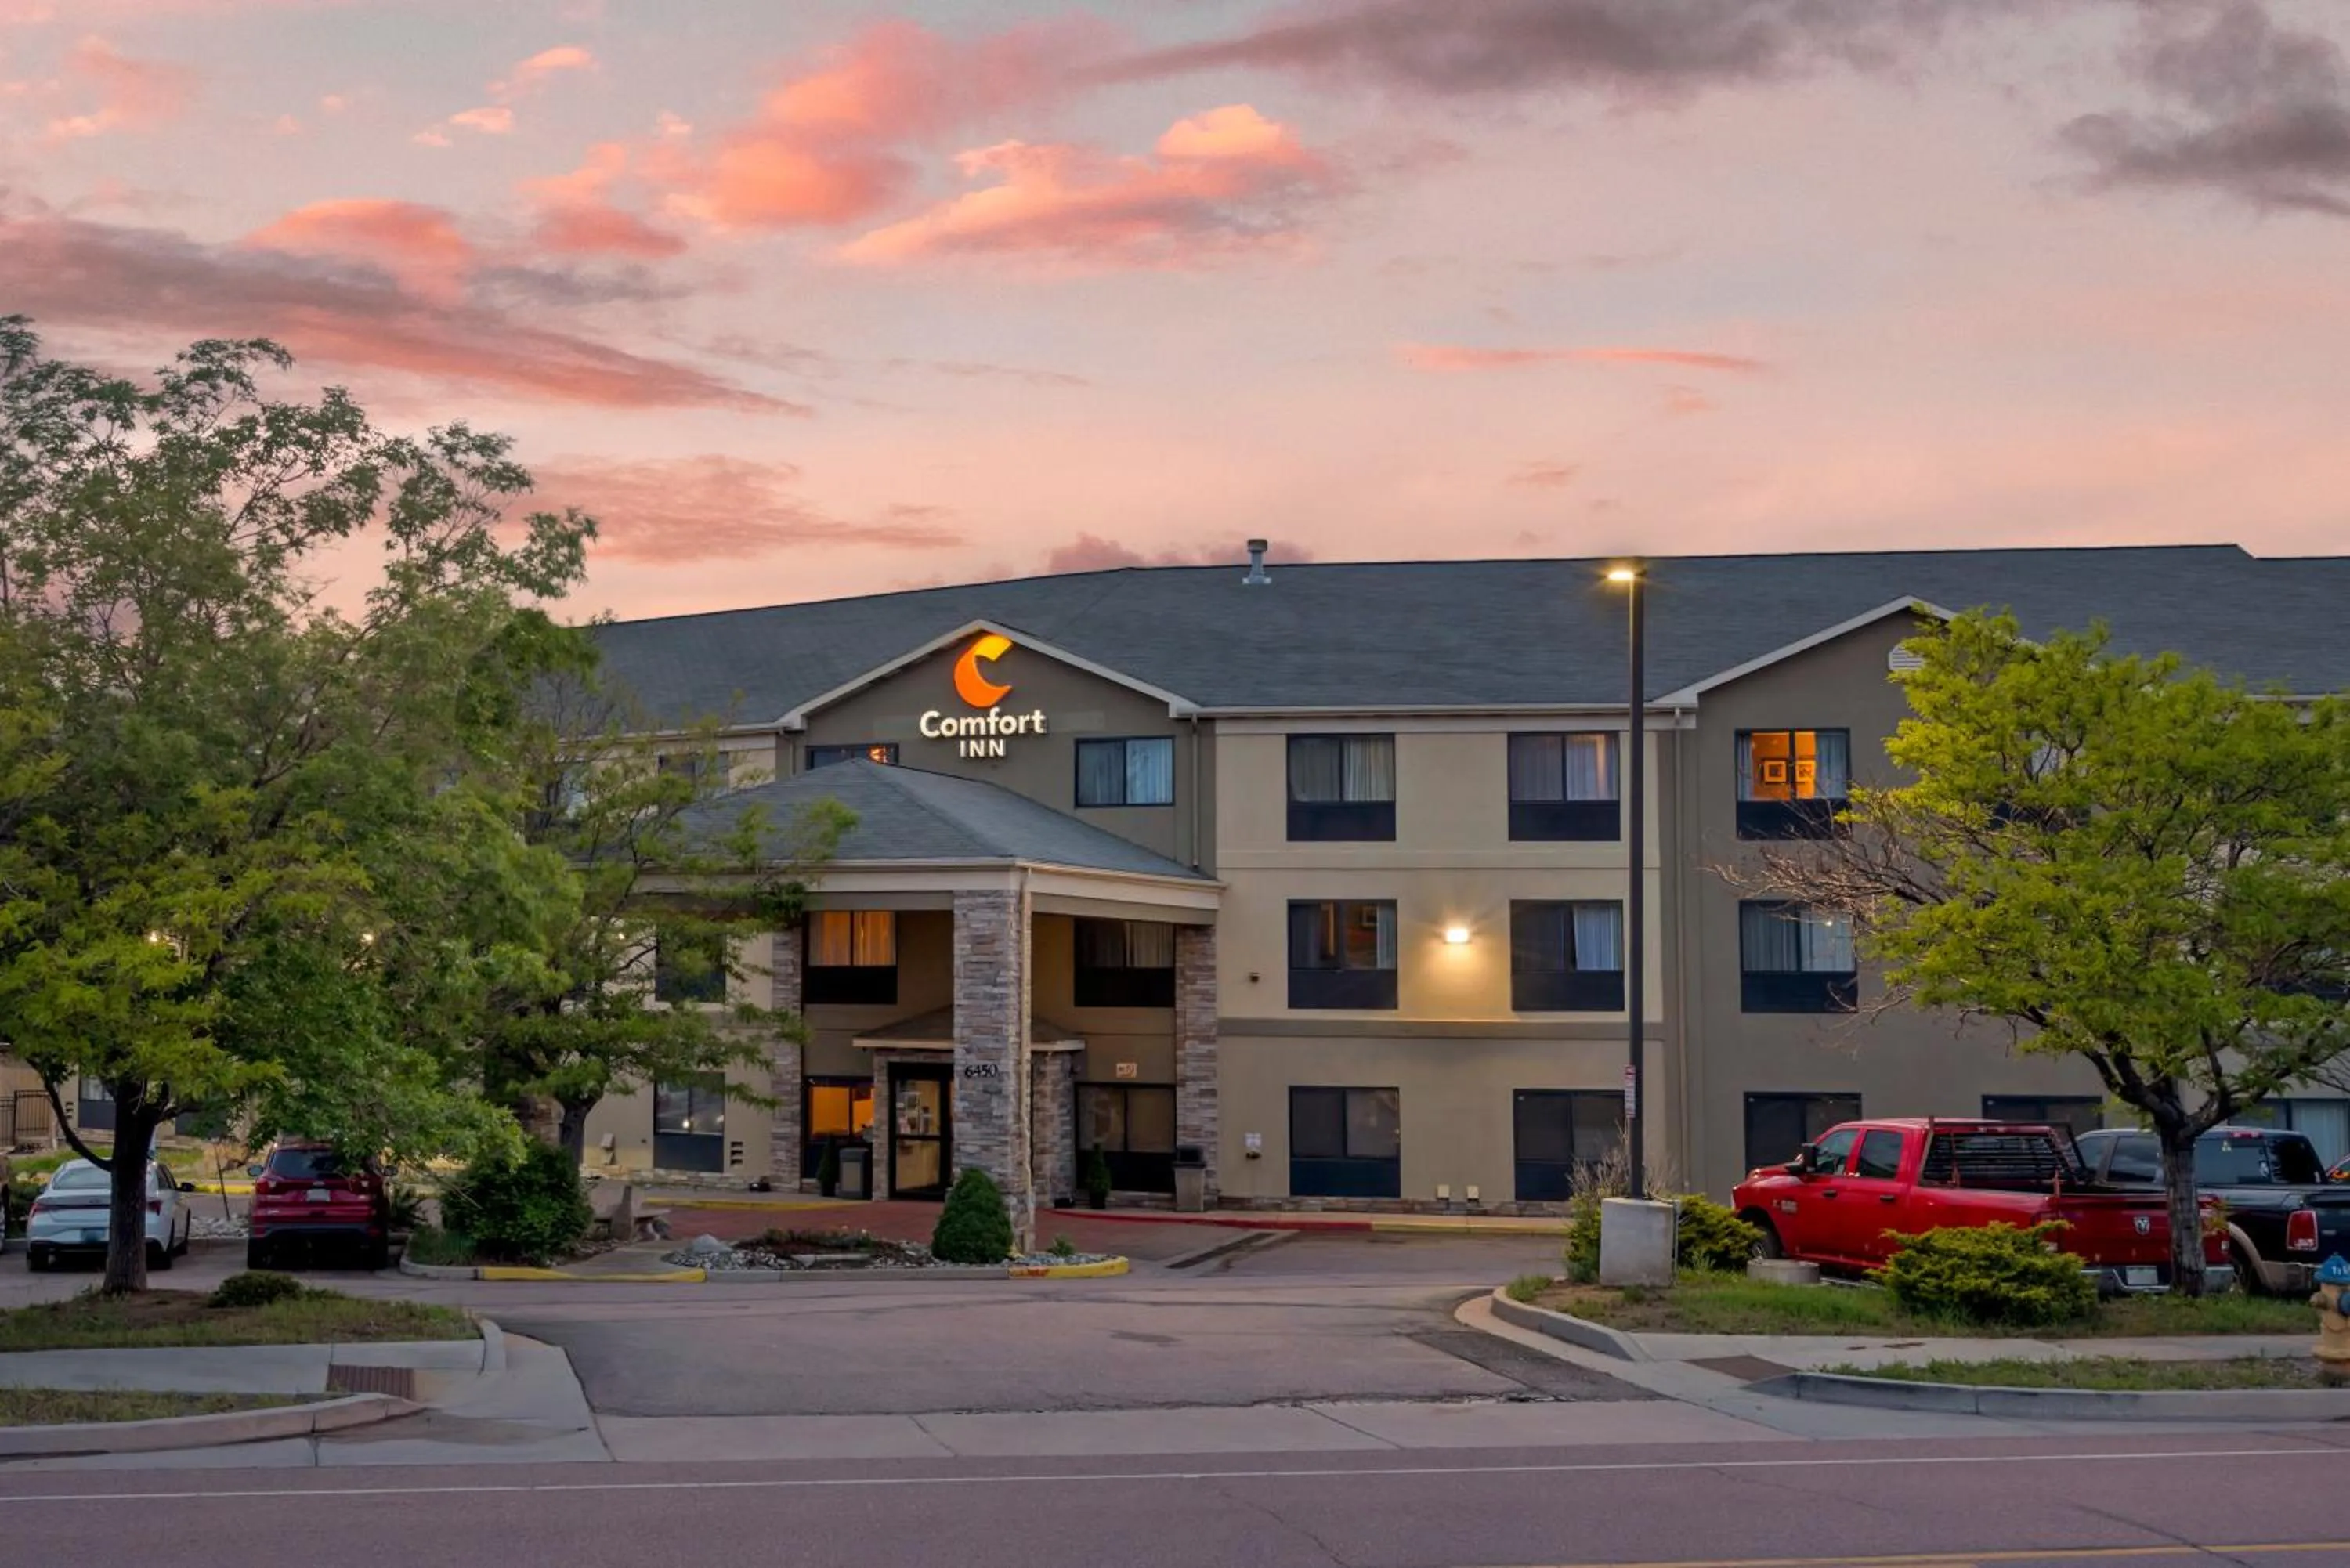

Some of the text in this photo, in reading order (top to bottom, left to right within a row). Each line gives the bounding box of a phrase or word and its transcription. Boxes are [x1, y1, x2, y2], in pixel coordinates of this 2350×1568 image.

[920, 706, 1046, 738] Comfort
[960, 739, 1005, 757] INN
[964, 1064, 998, 1078] 6450
